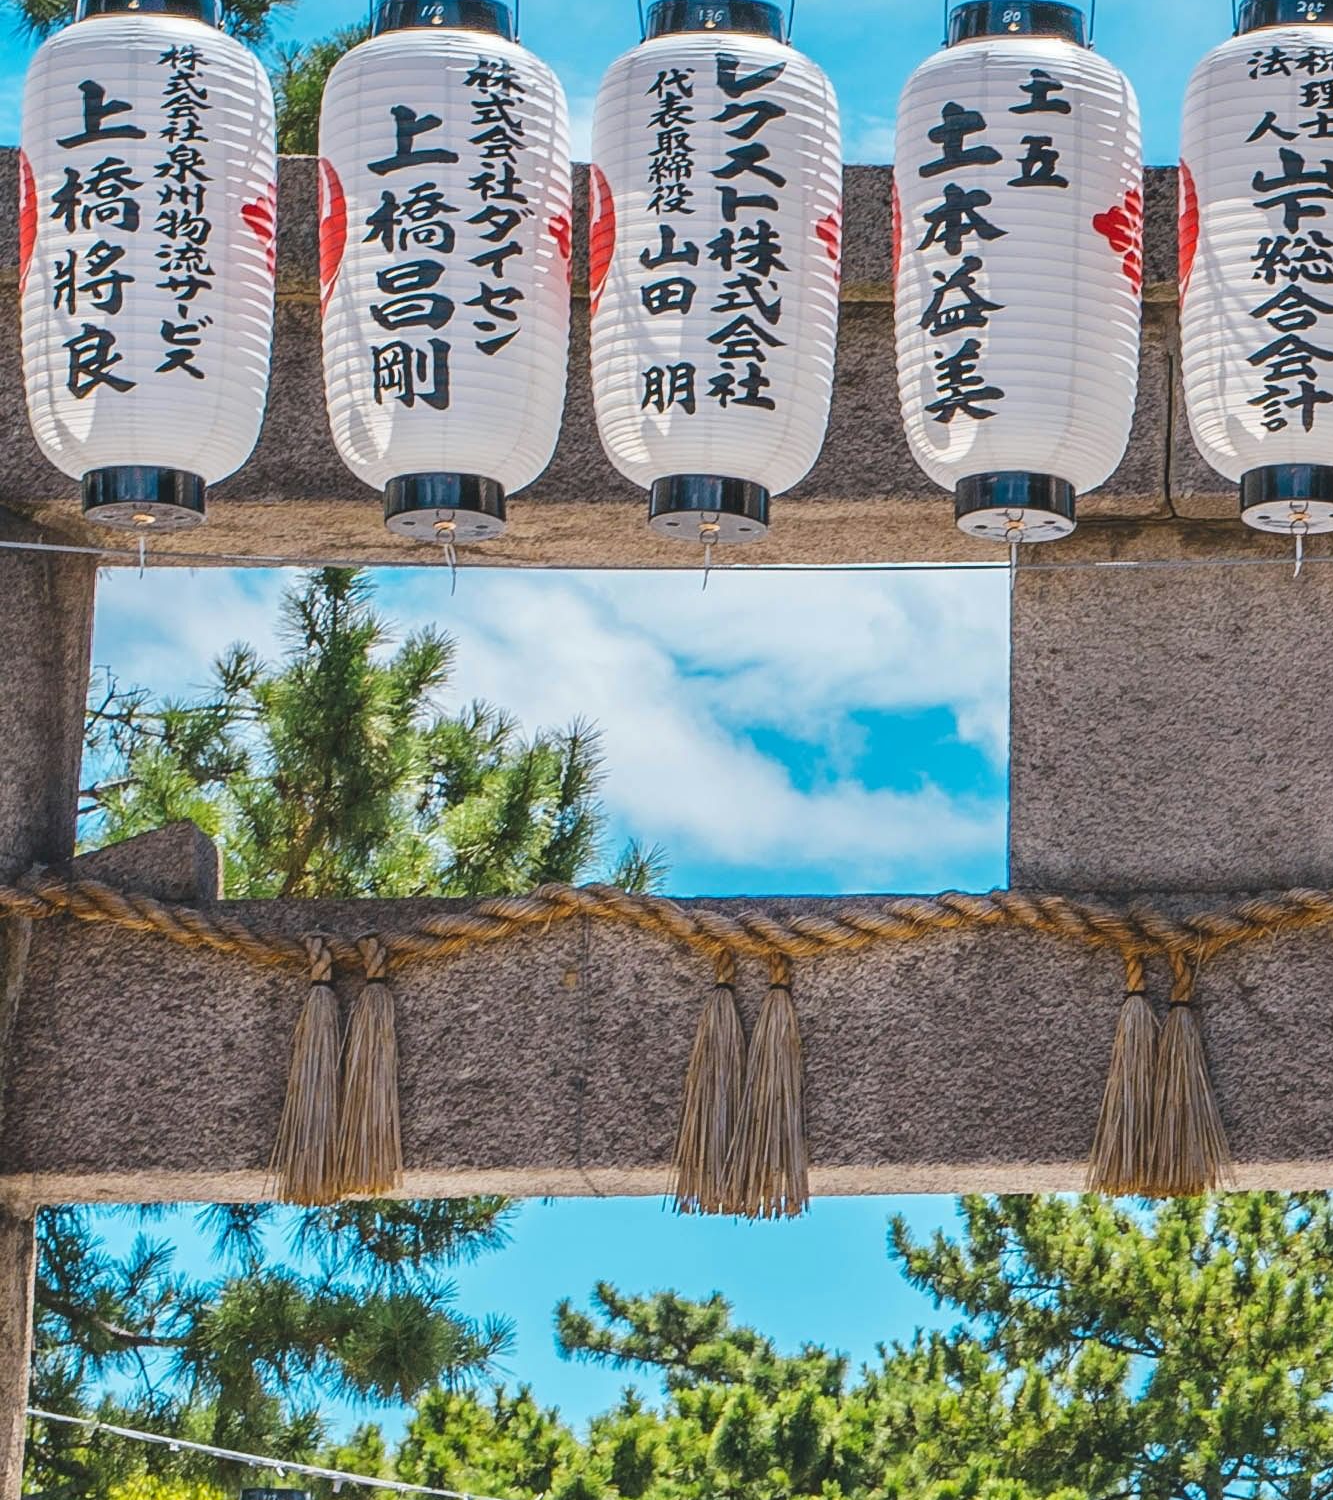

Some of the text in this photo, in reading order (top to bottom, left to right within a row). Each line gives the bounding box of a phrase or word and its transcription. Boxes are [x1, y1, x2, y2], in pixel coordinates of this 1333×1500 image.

[1002, 9, 1021, 22] 80
[1297, 0, 1325, 14] 205
[154, 43, 213, 379] 株式会社泉州物流サービス
[362, 105, 460, 411] 上橋昌剛
[464, 56, 536, 356] 株式会社ダイセン
[707, 52, 790, 411] レクスト株式会社
[916, 102, 1008, 424] 土本益美
